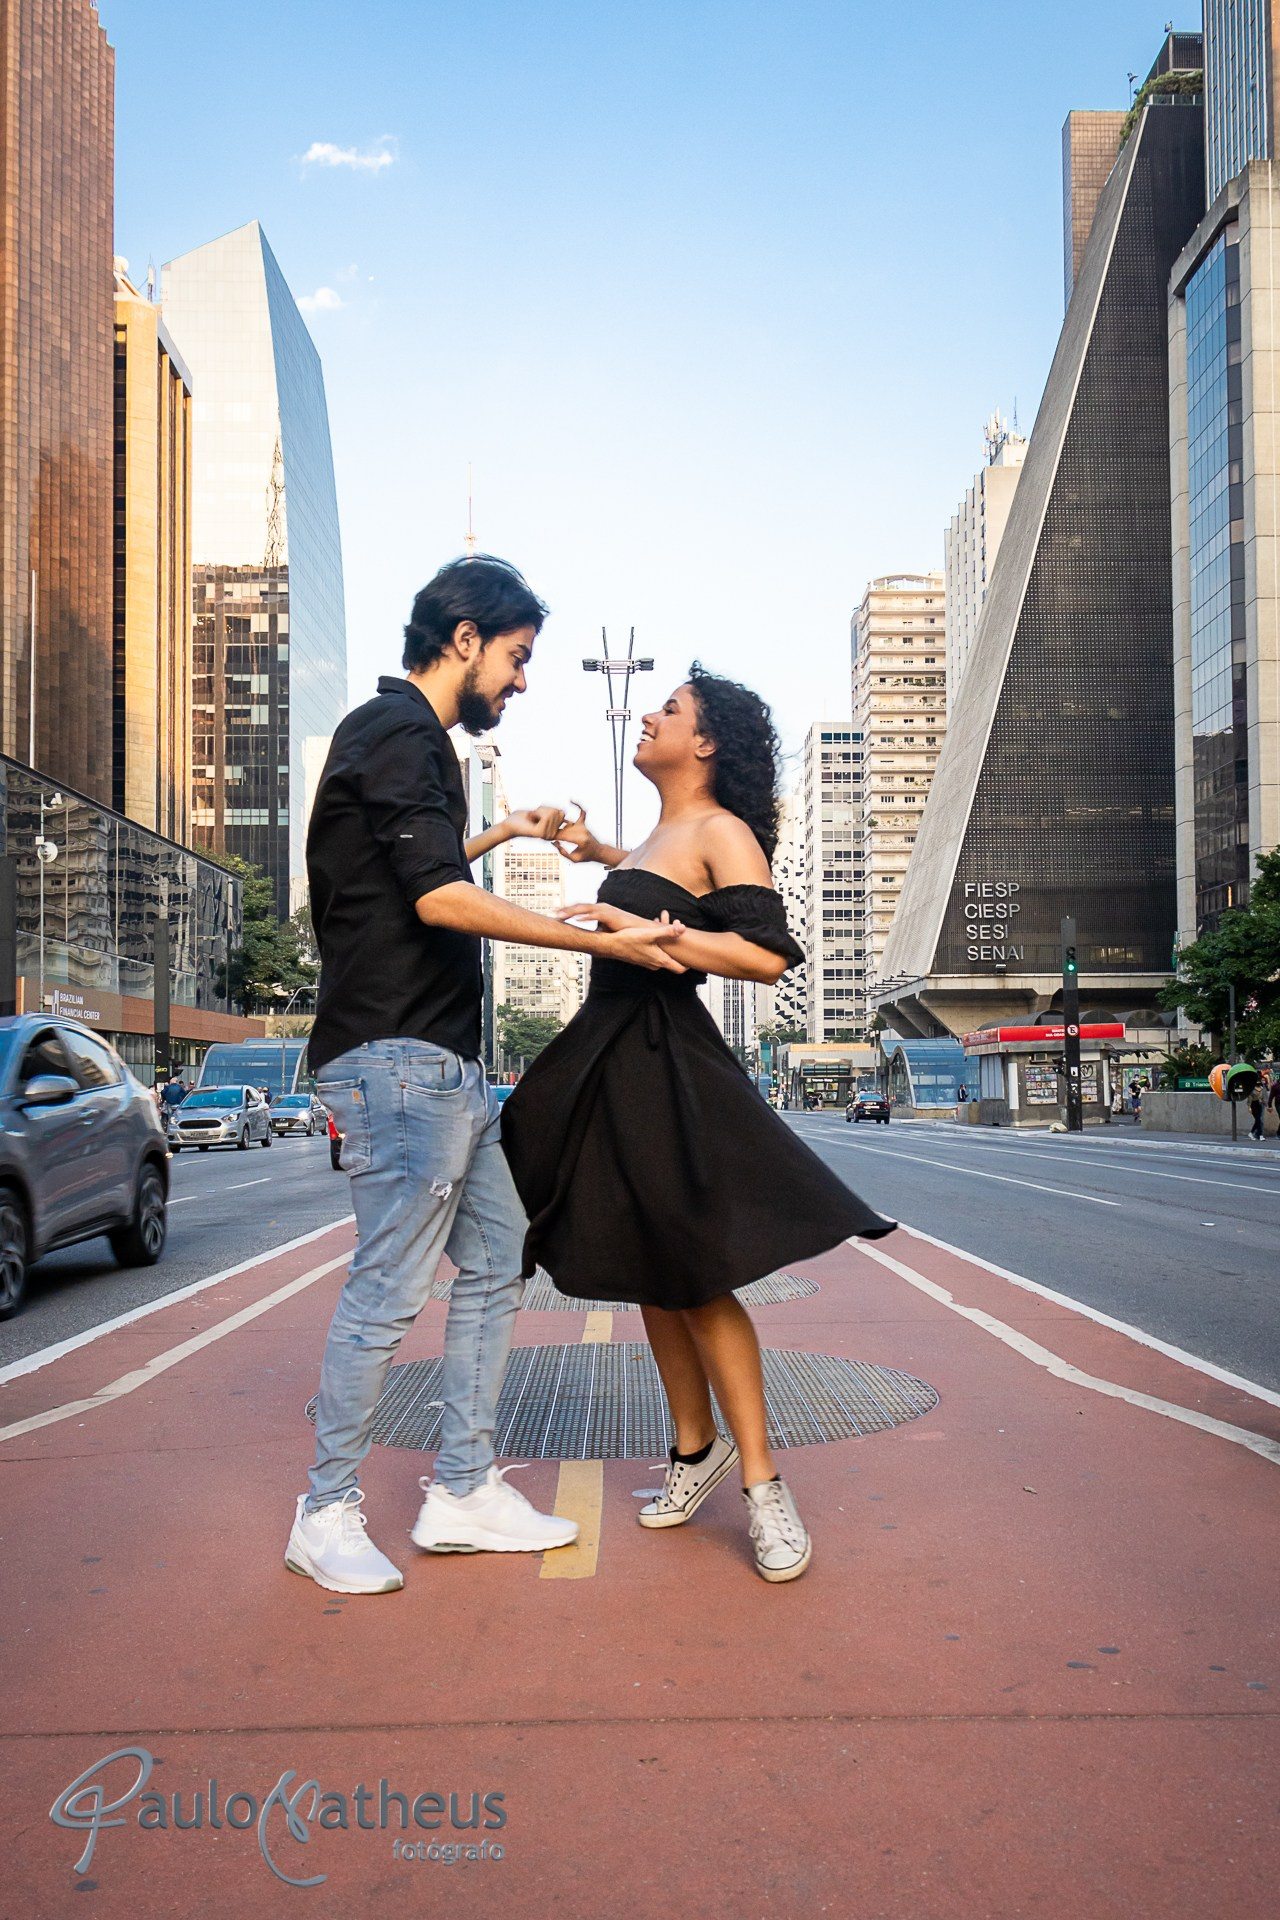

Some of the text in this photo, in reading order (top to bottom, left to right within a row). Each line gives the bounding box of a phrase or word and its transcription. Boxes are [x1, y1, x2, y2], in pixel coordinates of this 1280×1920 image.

[964, 882, 1020, 898] FIESP
[964, 903, 1021, 919] CIESP
[966, 924, 1009, 940] SESI
[967, 945, 1024, 961] SENAI
[60, 992, 83, 1005] BRAZILIAN
[60, 1007, 100, 1020] FINANCIAL CENTER
